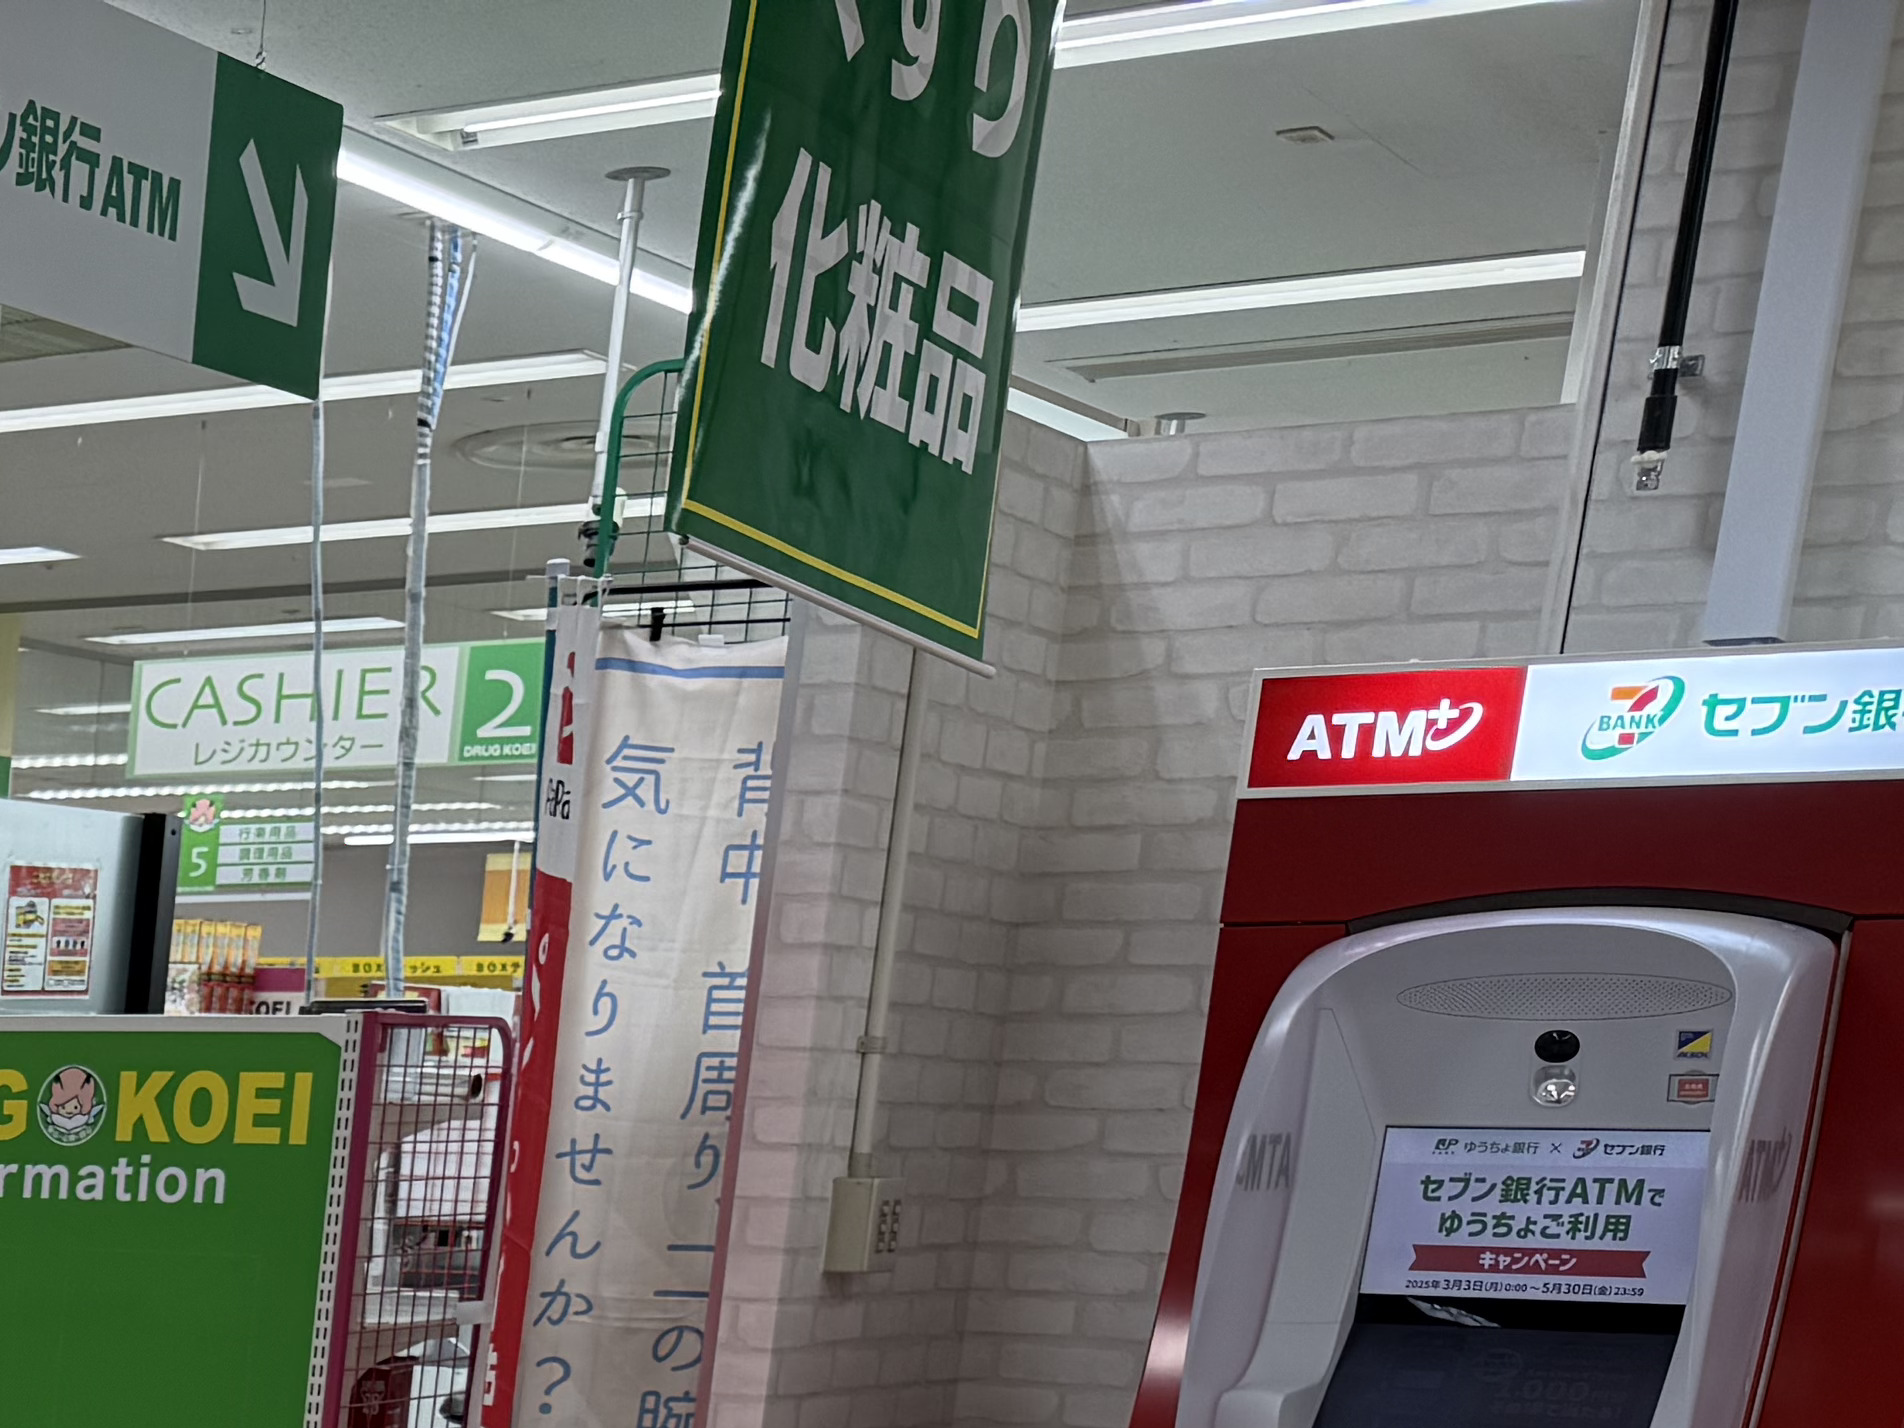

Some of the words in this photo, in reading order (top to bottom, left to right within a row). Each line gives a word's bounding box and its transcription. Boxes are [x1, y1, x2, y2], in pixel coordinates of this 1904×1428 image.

[761, 148, 993, 474] 化粧品
[145, 664, 442, 730] CASHIER
[476, 669, 532, 739] 2
[1702, 686, 1904, 740] セブン銀
[1599, 713, 1660, 733] BANK
[193, 734, 384, 766] レジカウンター
[189, 846, 209, 878] 5
[114, 1070, 314, 1146] KOEI
[1465, 1141, 1540, 1155] ゆうちょ銀行
[1603, 1143, 1666, 1157] セブン銀行
[1420, 1172, 1666, 1207] セブン銀行ATMで
[1438, 1210, 1633, 1242] ゆうちょご利用
[1479, 1251, 1578, 1272] キャンペーン
